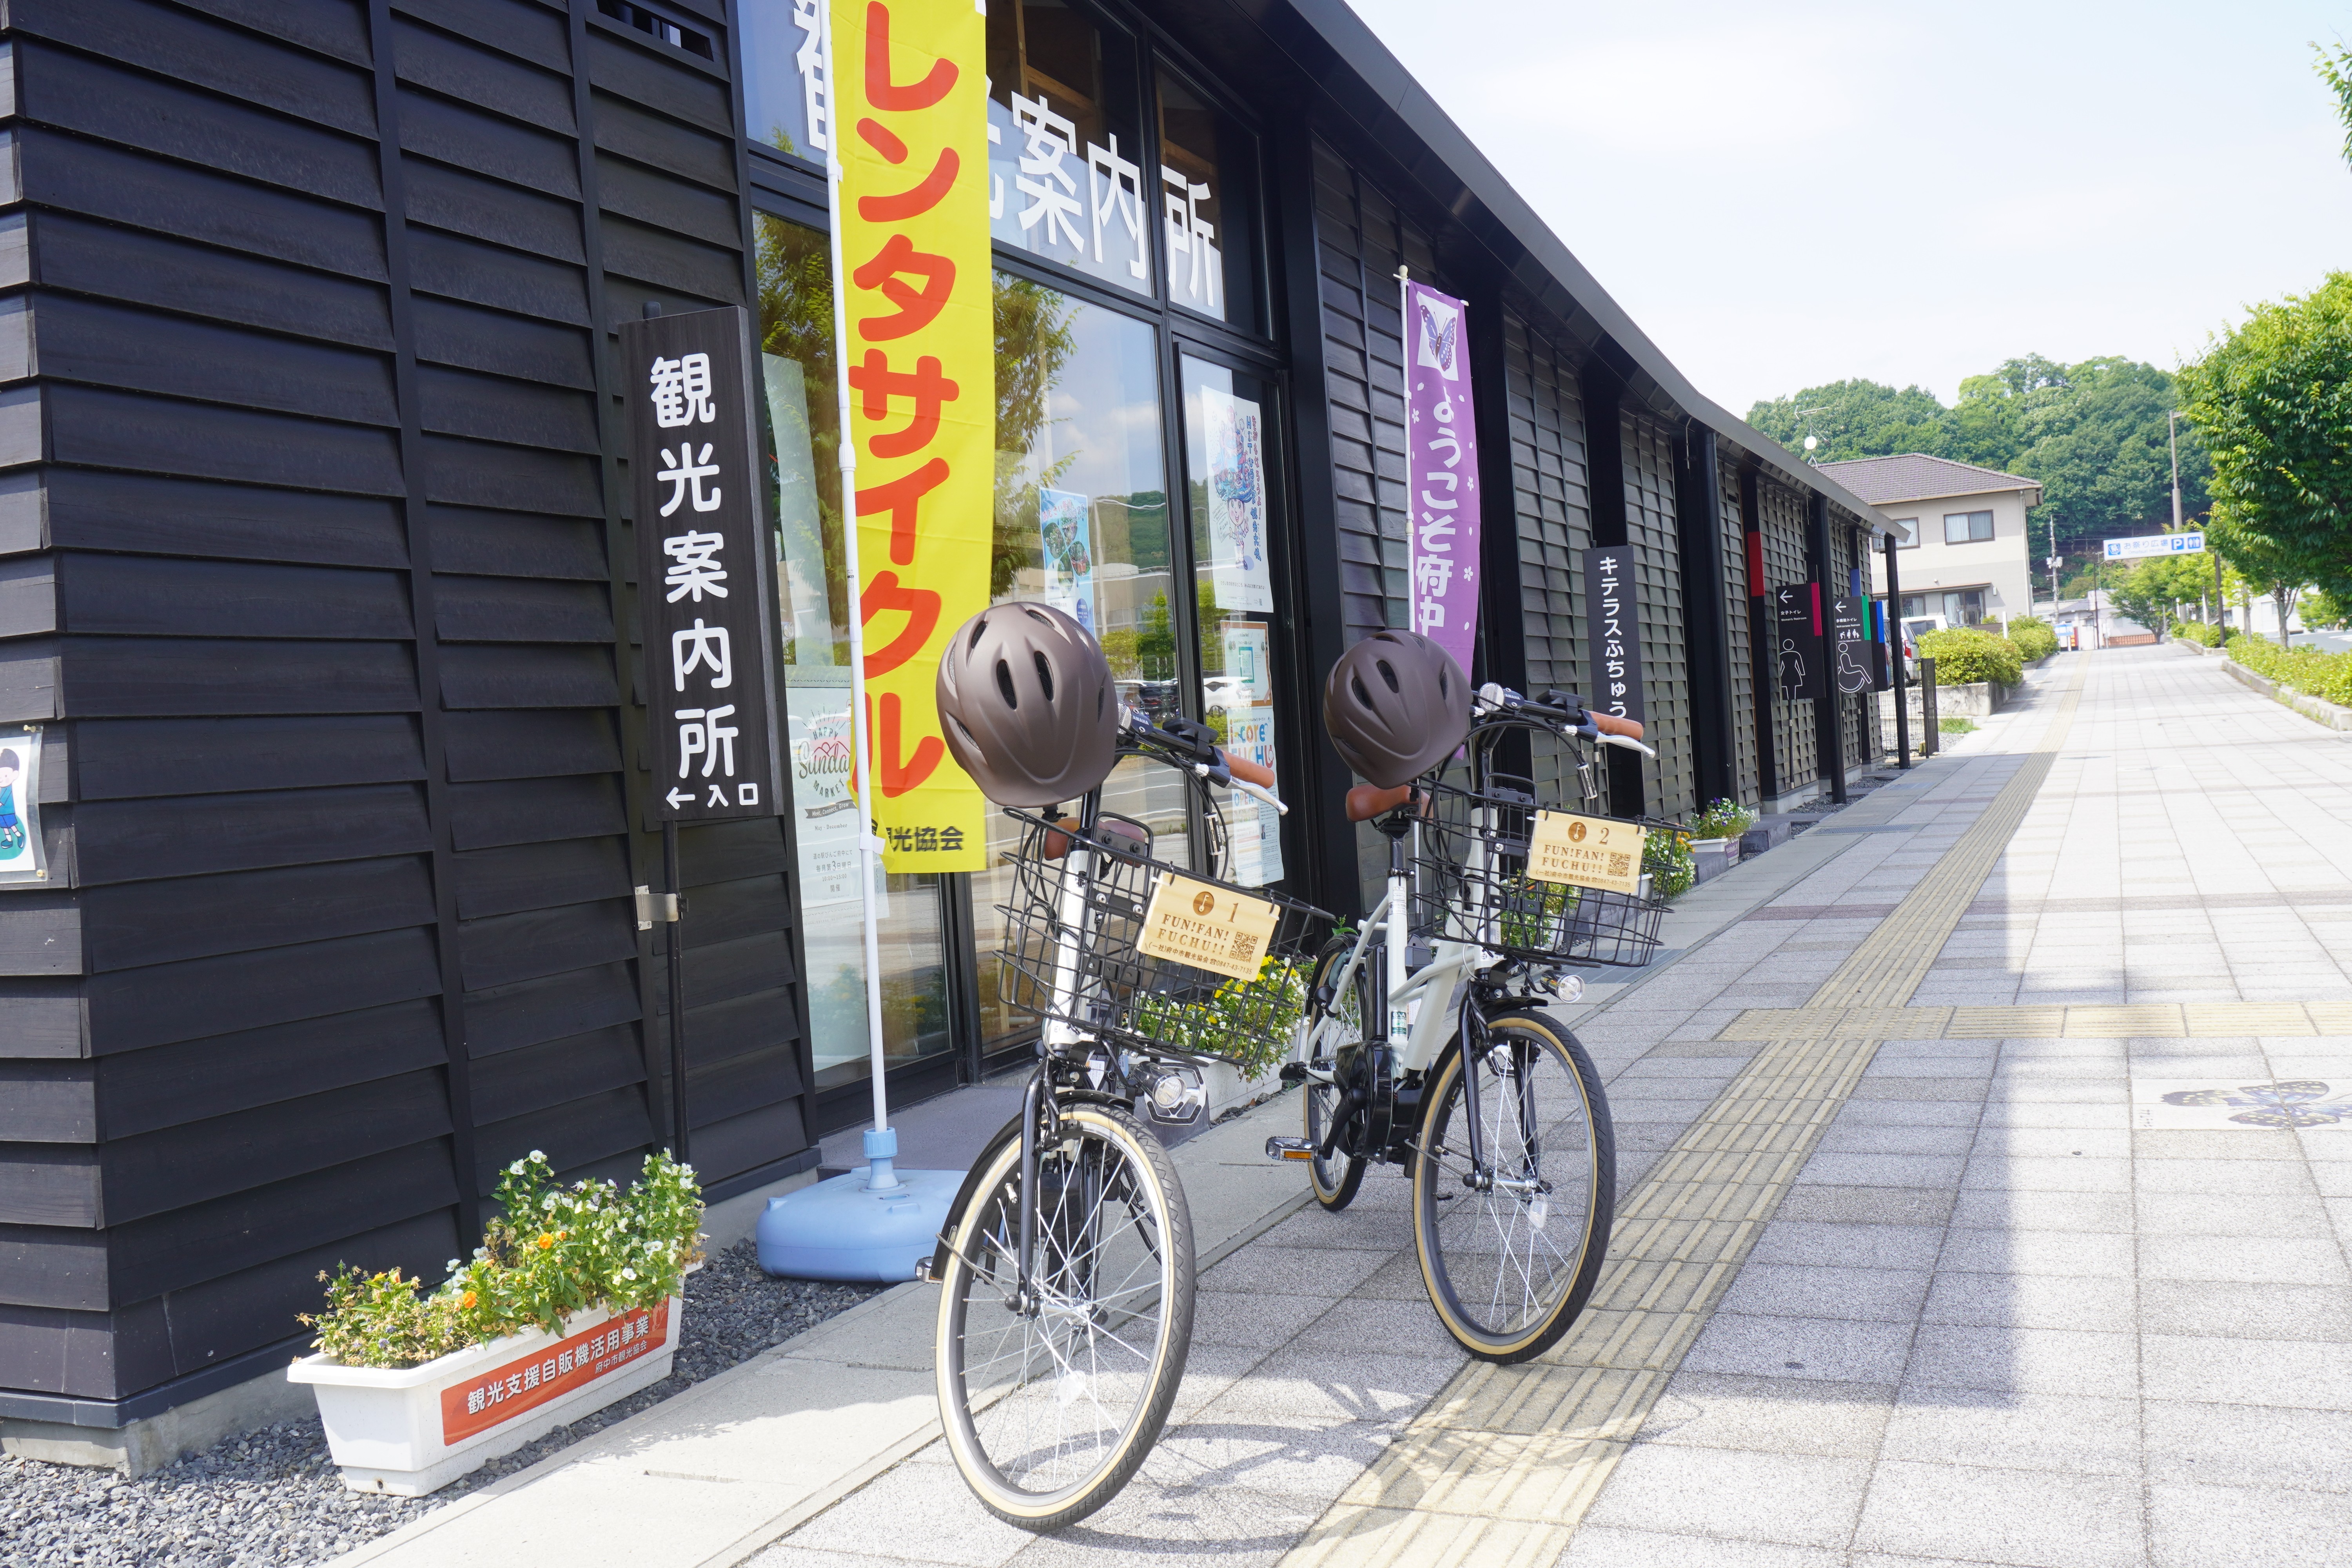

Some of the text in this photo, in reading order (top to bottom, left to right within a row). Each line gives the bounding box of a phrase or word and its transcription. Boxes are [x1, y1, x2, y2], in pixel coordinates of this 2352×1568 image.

[848, 1, 960, 797] レンタサイクル
[2124, 539, 2168, 549] お祭り広場
[650, 353, 739, 779] 観光案内所
[1600, 557, 1627, 718] キテラスふちゅう
[813, 726, 838, 740] HAPPY
[798, 741, 850, 779] Sunda
[707, 783, 759, 808] 入口
[813, 778, 844, 798] MARKET
[822, 806, 838, 815] Connect,
[885, 826, 965, 852] 光協会
[1599, 828, 1609, 845] 2
[1544, 844, 1604, 861] FUN!FAN!
[816, 860, 851, 872] 毎月第3日曜日
[1542, 857, 1602, 873] FUCHU!!
[830, 884, 840, 893] 開催
[1227, 903, 1239, 923] 1
[1161, 914, 1229, 941] FUN!FAN!
[1157, 928, 1225, 955] FUCHU!!
[468, 1315, 649, 1415] 観光支援自販機活用事業
[595, 1340, 647, 1374] 府中市観光協会
